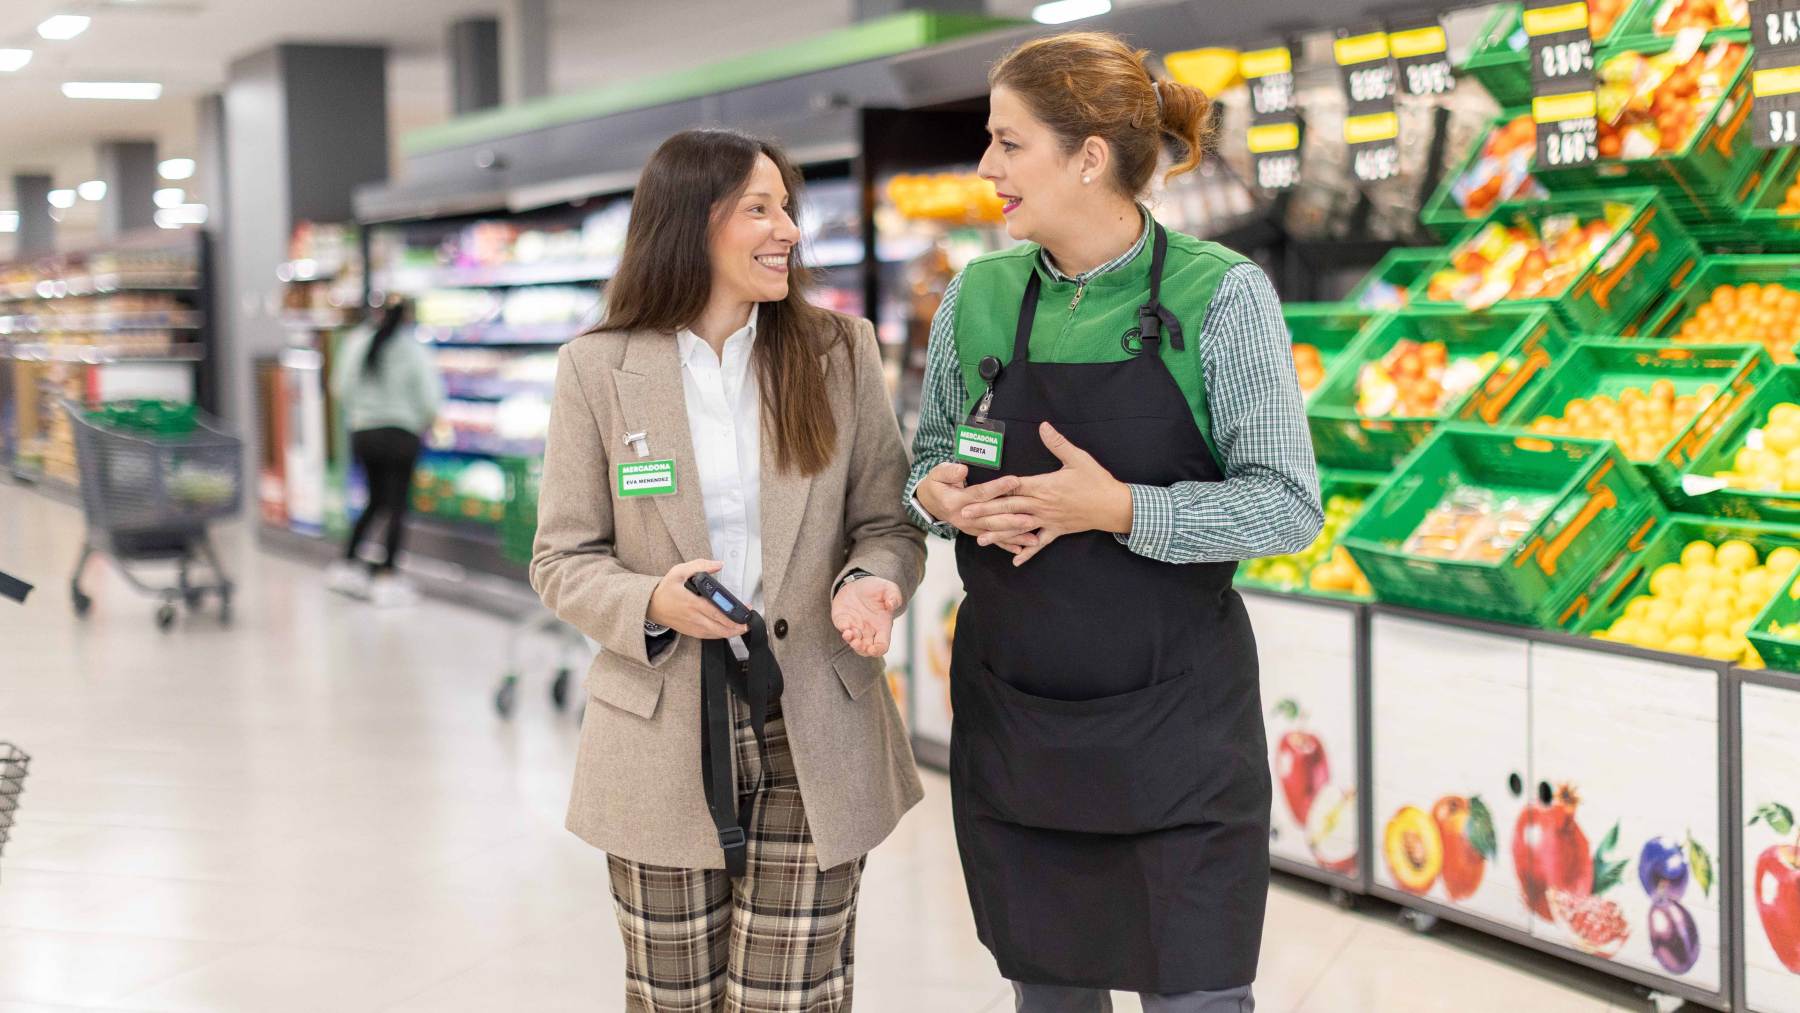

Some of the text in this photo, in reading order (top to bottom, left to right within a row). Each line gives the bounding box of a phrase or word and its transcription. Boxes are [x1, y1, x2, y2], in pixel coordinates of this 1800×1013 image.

[960, 431, 998, 444] MERCADONA
[969, 446, 986, 455] BERTA
[623, 464, 671, 473] MERCADONA
